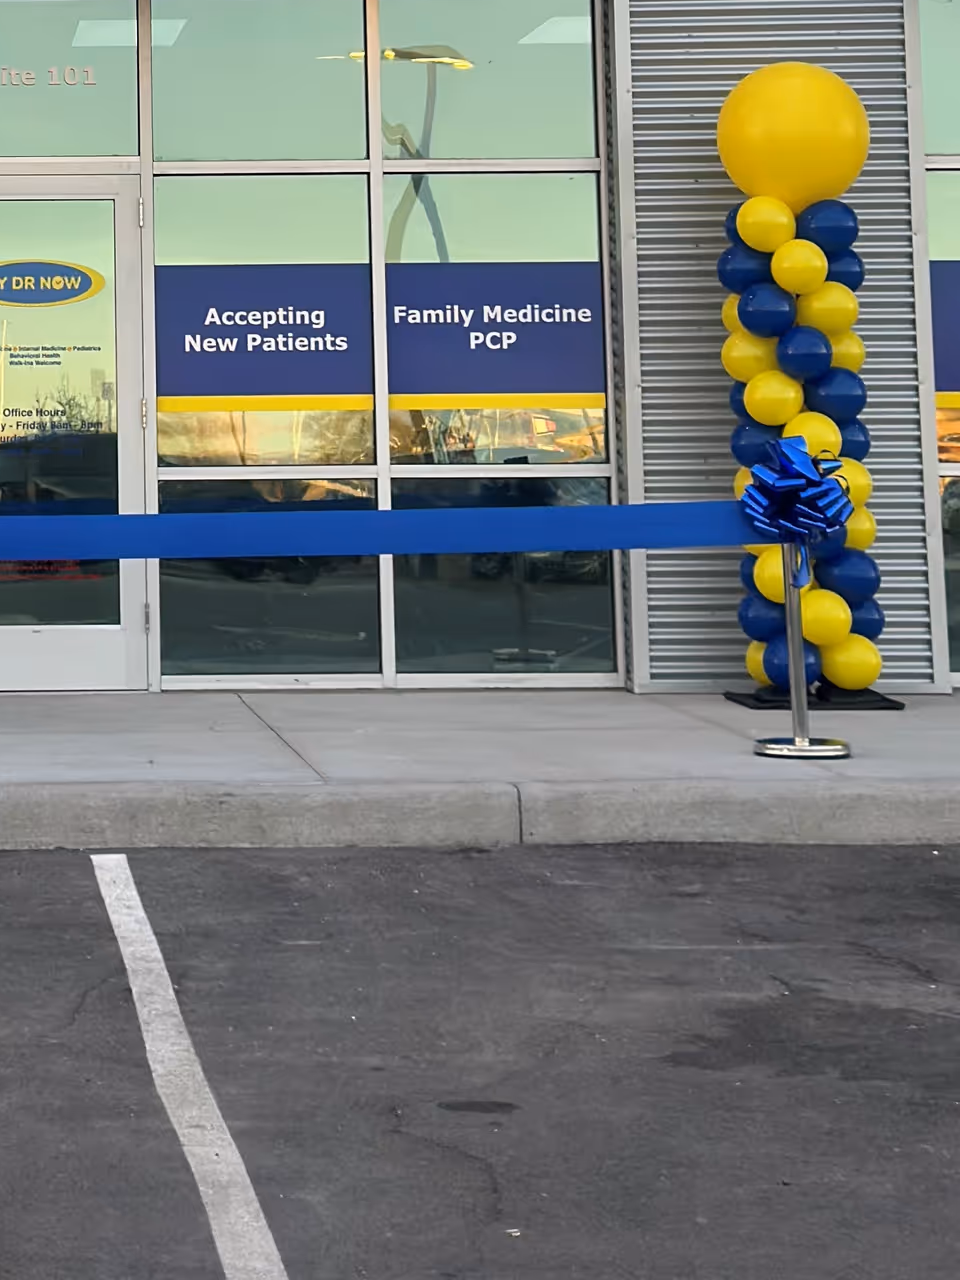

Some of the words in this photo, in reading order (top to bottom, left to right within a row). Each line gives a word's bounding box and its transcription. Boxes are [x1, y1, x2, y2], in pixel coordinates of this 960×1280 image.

[47, 66, 97, 87] 101
[11, 276, 35, 290] DR
[40, 275, 82, 290] NOW
[204, 307, 326, 330] Accepting
[393, 305, 474, 328] Family
[483, 303, 592, 324] Medicine
[184, 334, 238, 352] New
[246, 331, 348, 352] Patients
[469, 331, 517, 350] PCP
[3, 408, 33, 417] Office
[36, 408, 67, 417] Hours
[16, 421, 47, 431] Friday
